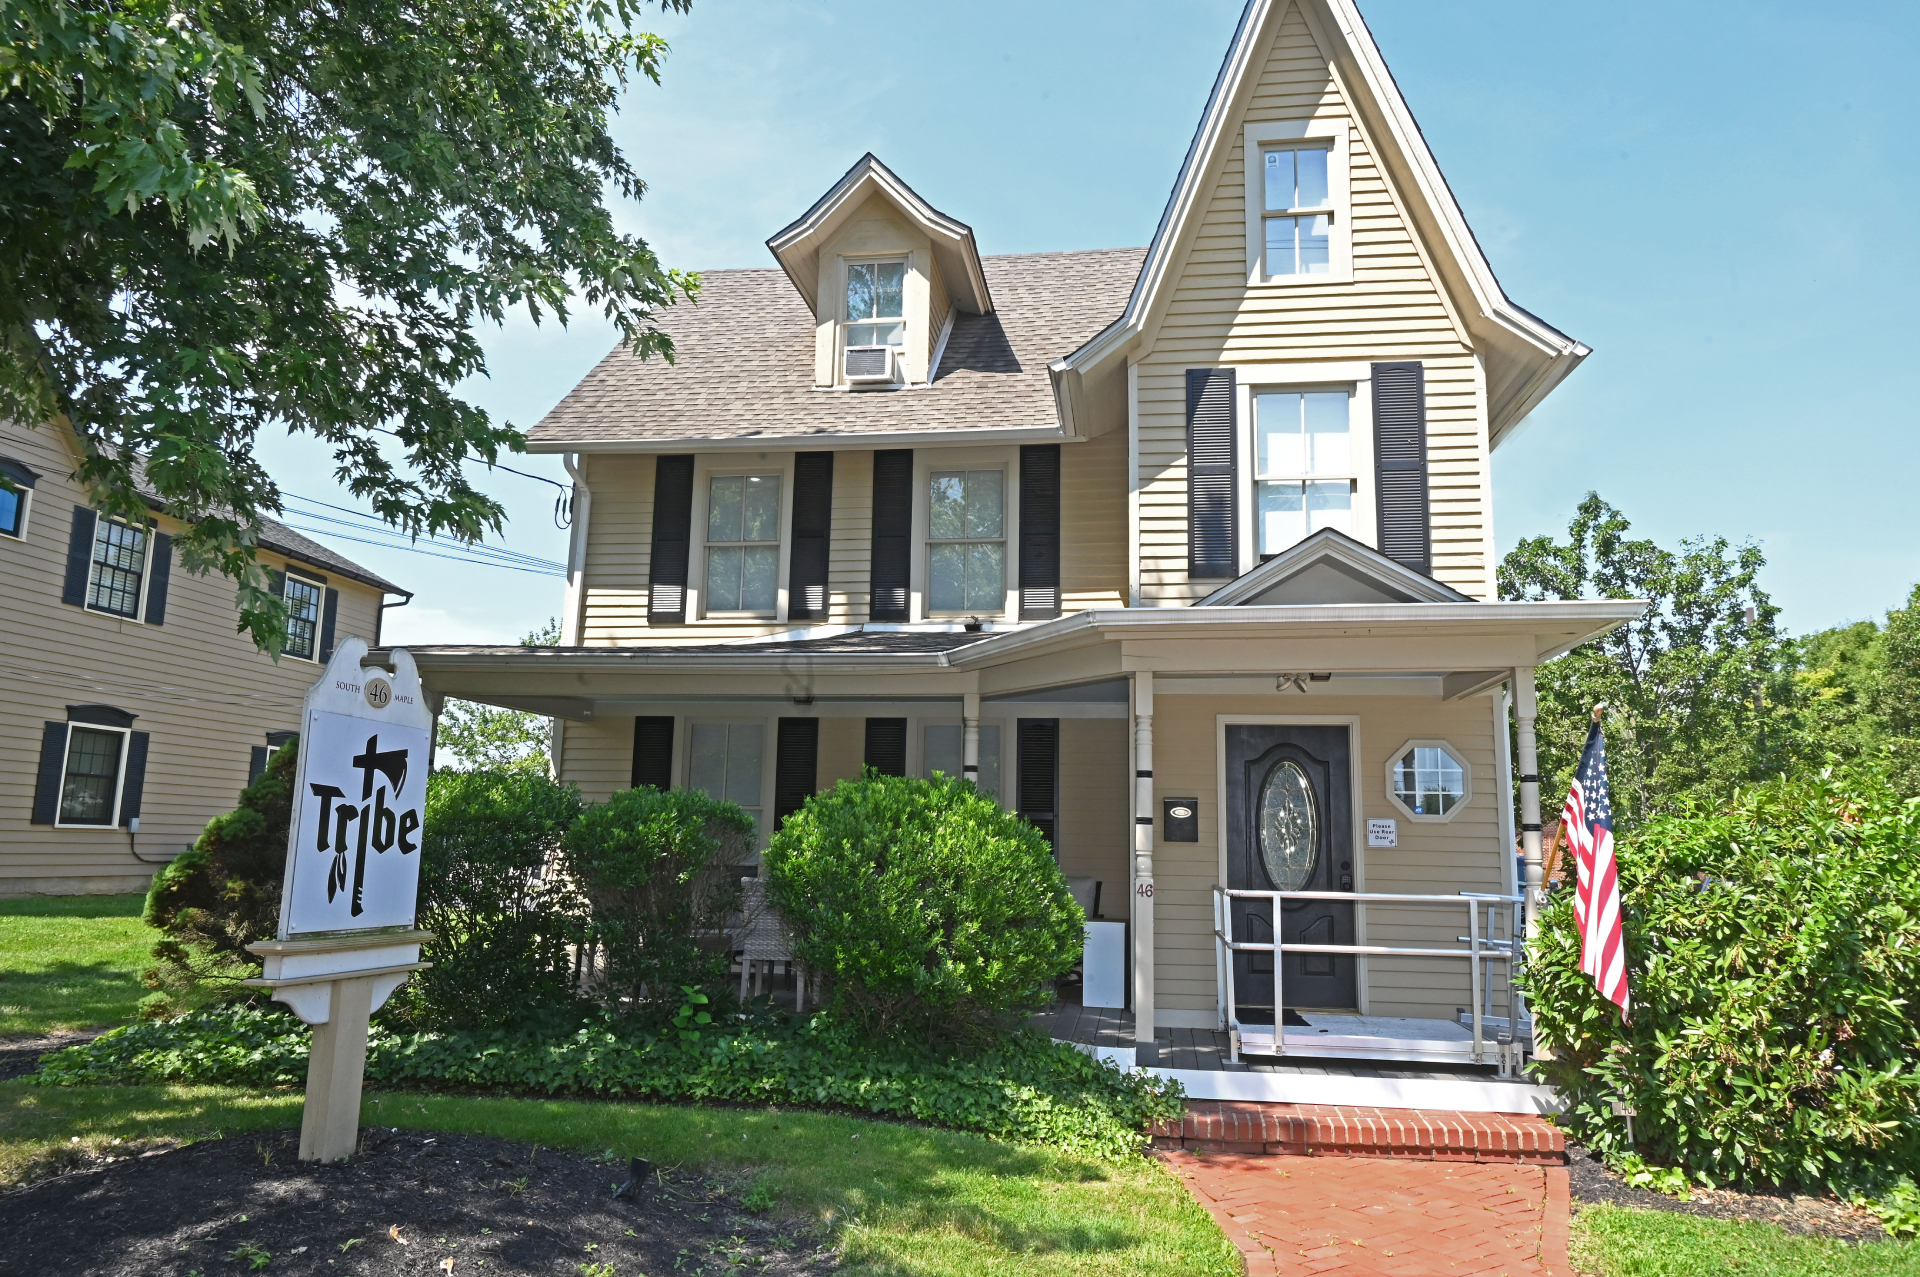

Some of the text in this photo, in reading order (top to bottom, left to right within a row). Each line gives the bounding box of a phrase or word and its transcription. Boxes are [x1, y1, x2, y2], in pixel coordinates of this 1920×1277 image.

[335, 680, 414, 705] SOUTH 46 MAPLE
[309, 782, 420, 918] Tribe
[1136, 883, 1154, 898] 46
